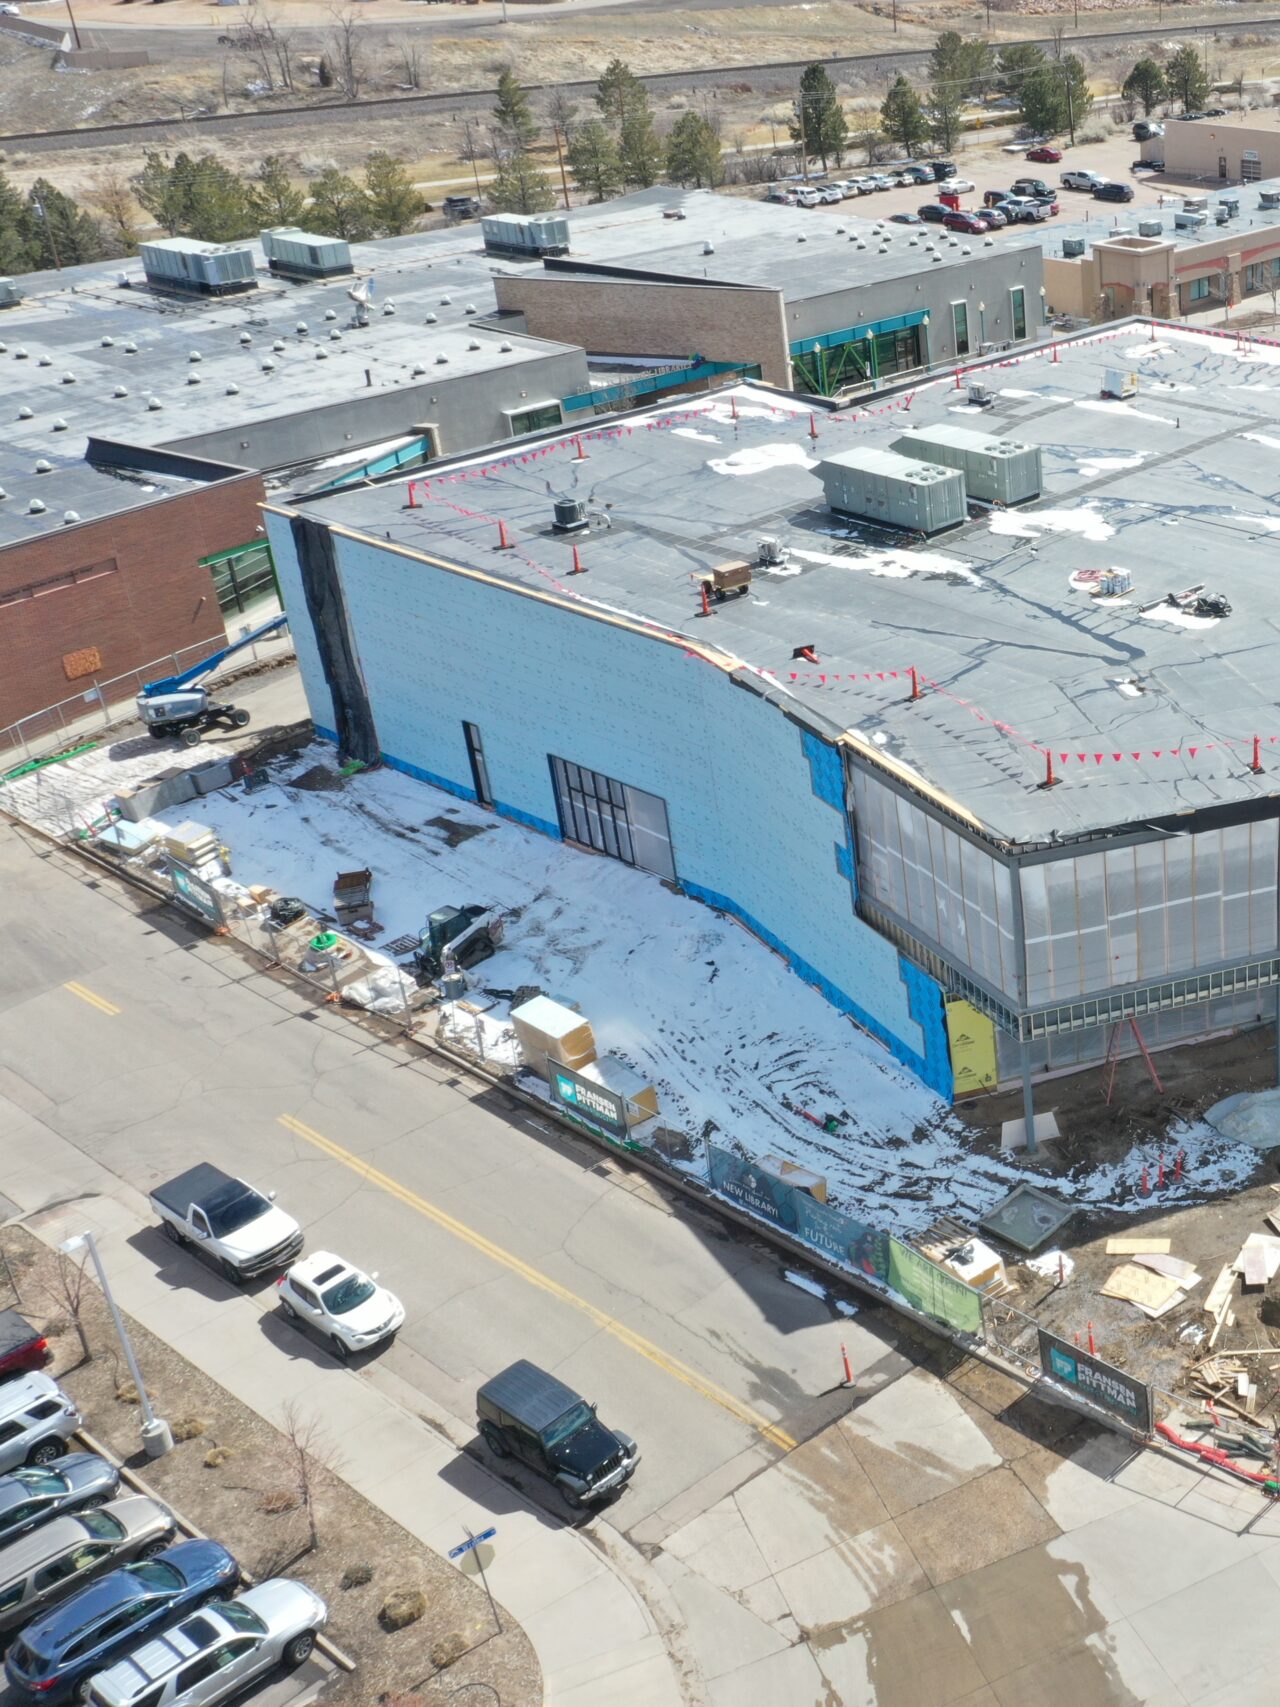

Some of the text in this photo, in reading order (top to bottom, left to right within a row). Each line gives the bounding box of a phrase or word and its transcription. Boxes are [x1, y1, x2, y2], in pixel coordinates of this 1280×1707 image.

[575, 1084, 616, 1112] FRANSEN
[577, 1094, 618, 1120] PITTMAN
[723, 1181, 743, 1197] NEW
[744, 1191, 778, 1218] LIBRARY!
[804, 1226, 845, 1253] FUTURE
[1077, 1362, 1136, 1400] FRANSEN
[1077, 1372, 1137, 1409] PITTMAN
